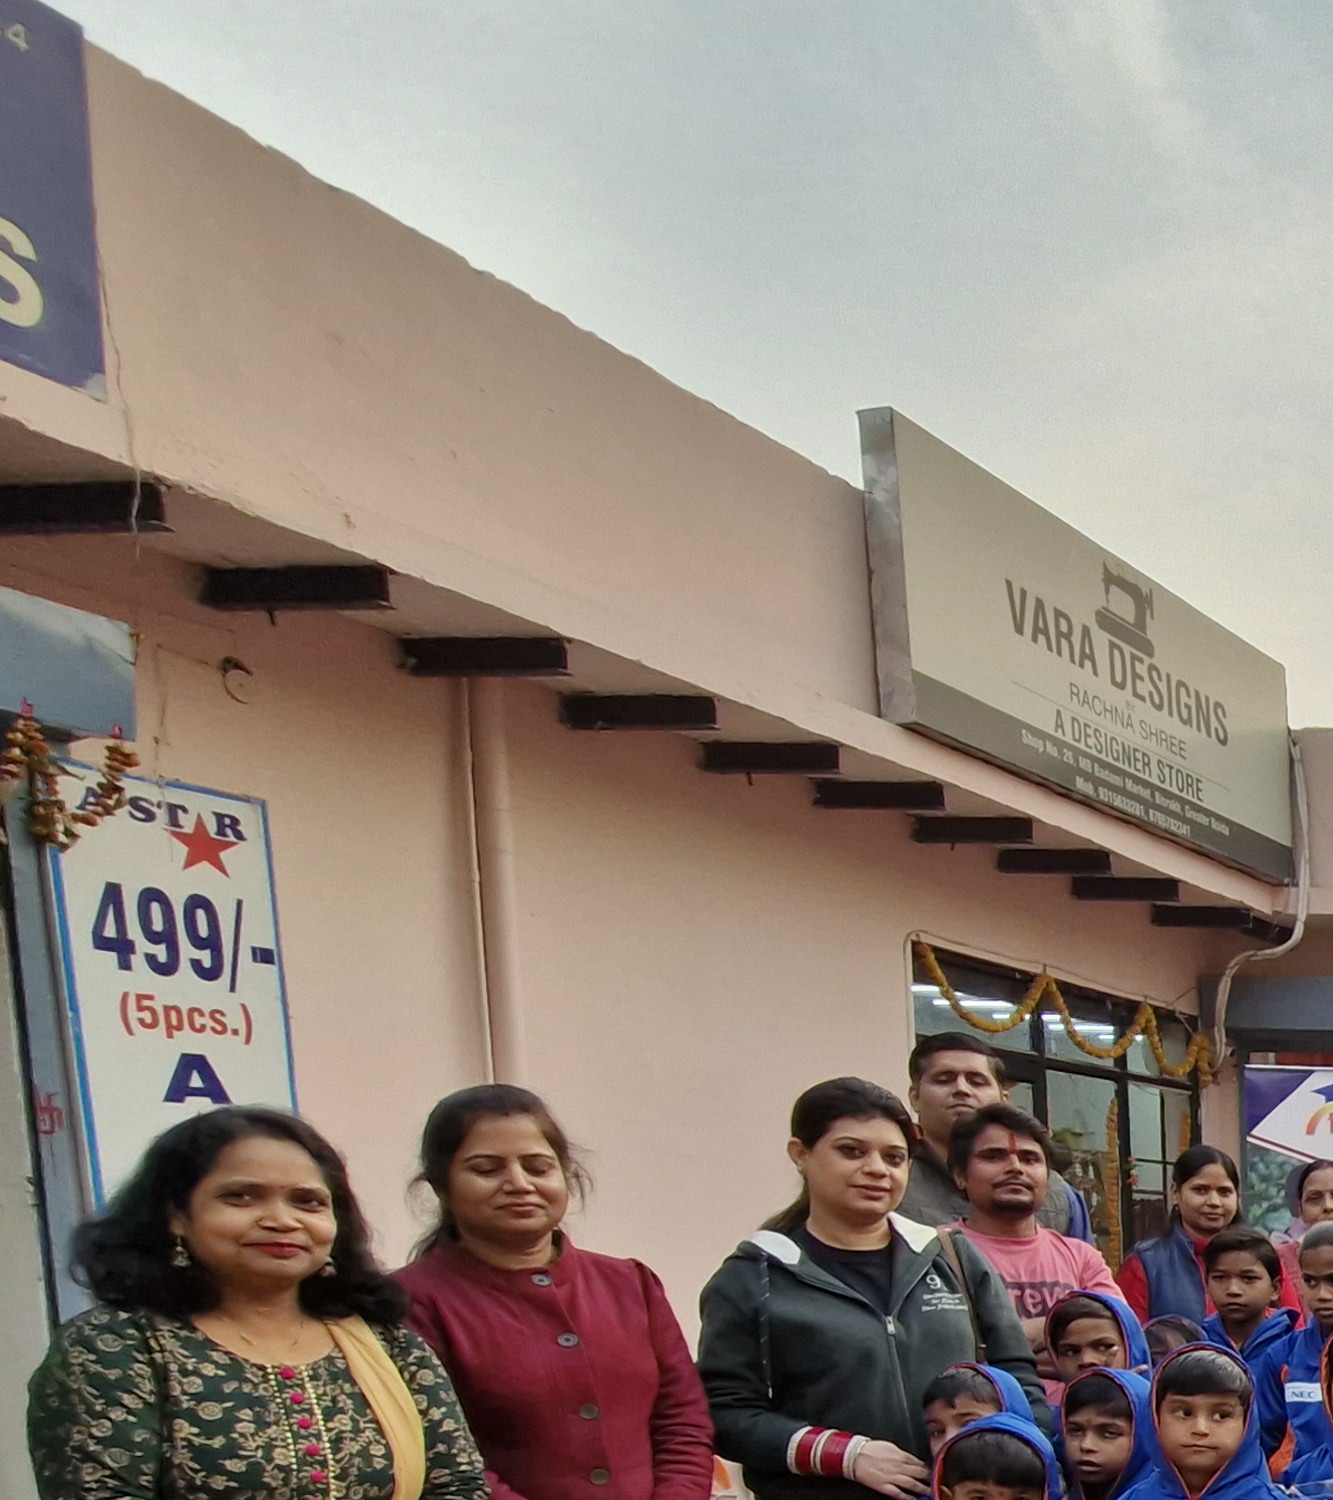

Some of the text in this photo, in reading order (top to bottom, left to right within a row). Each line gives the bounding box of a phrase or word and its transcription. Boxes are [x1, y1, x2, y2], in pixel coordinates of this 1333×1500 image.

[1005, 577, 1229, 746] VARA DESIGNS
[1022, 729, 1046, 753] Shop
[1054, 709, 1204, 802] A DESIGNER STORE
[1069, 682, 1187, 760] RACHNA SHREE
[91, 881, 277, 994] 499/-
[119, 991, 254, 1046] (5pcs.)
[1290, 1390, 1316, 1399] NEC
